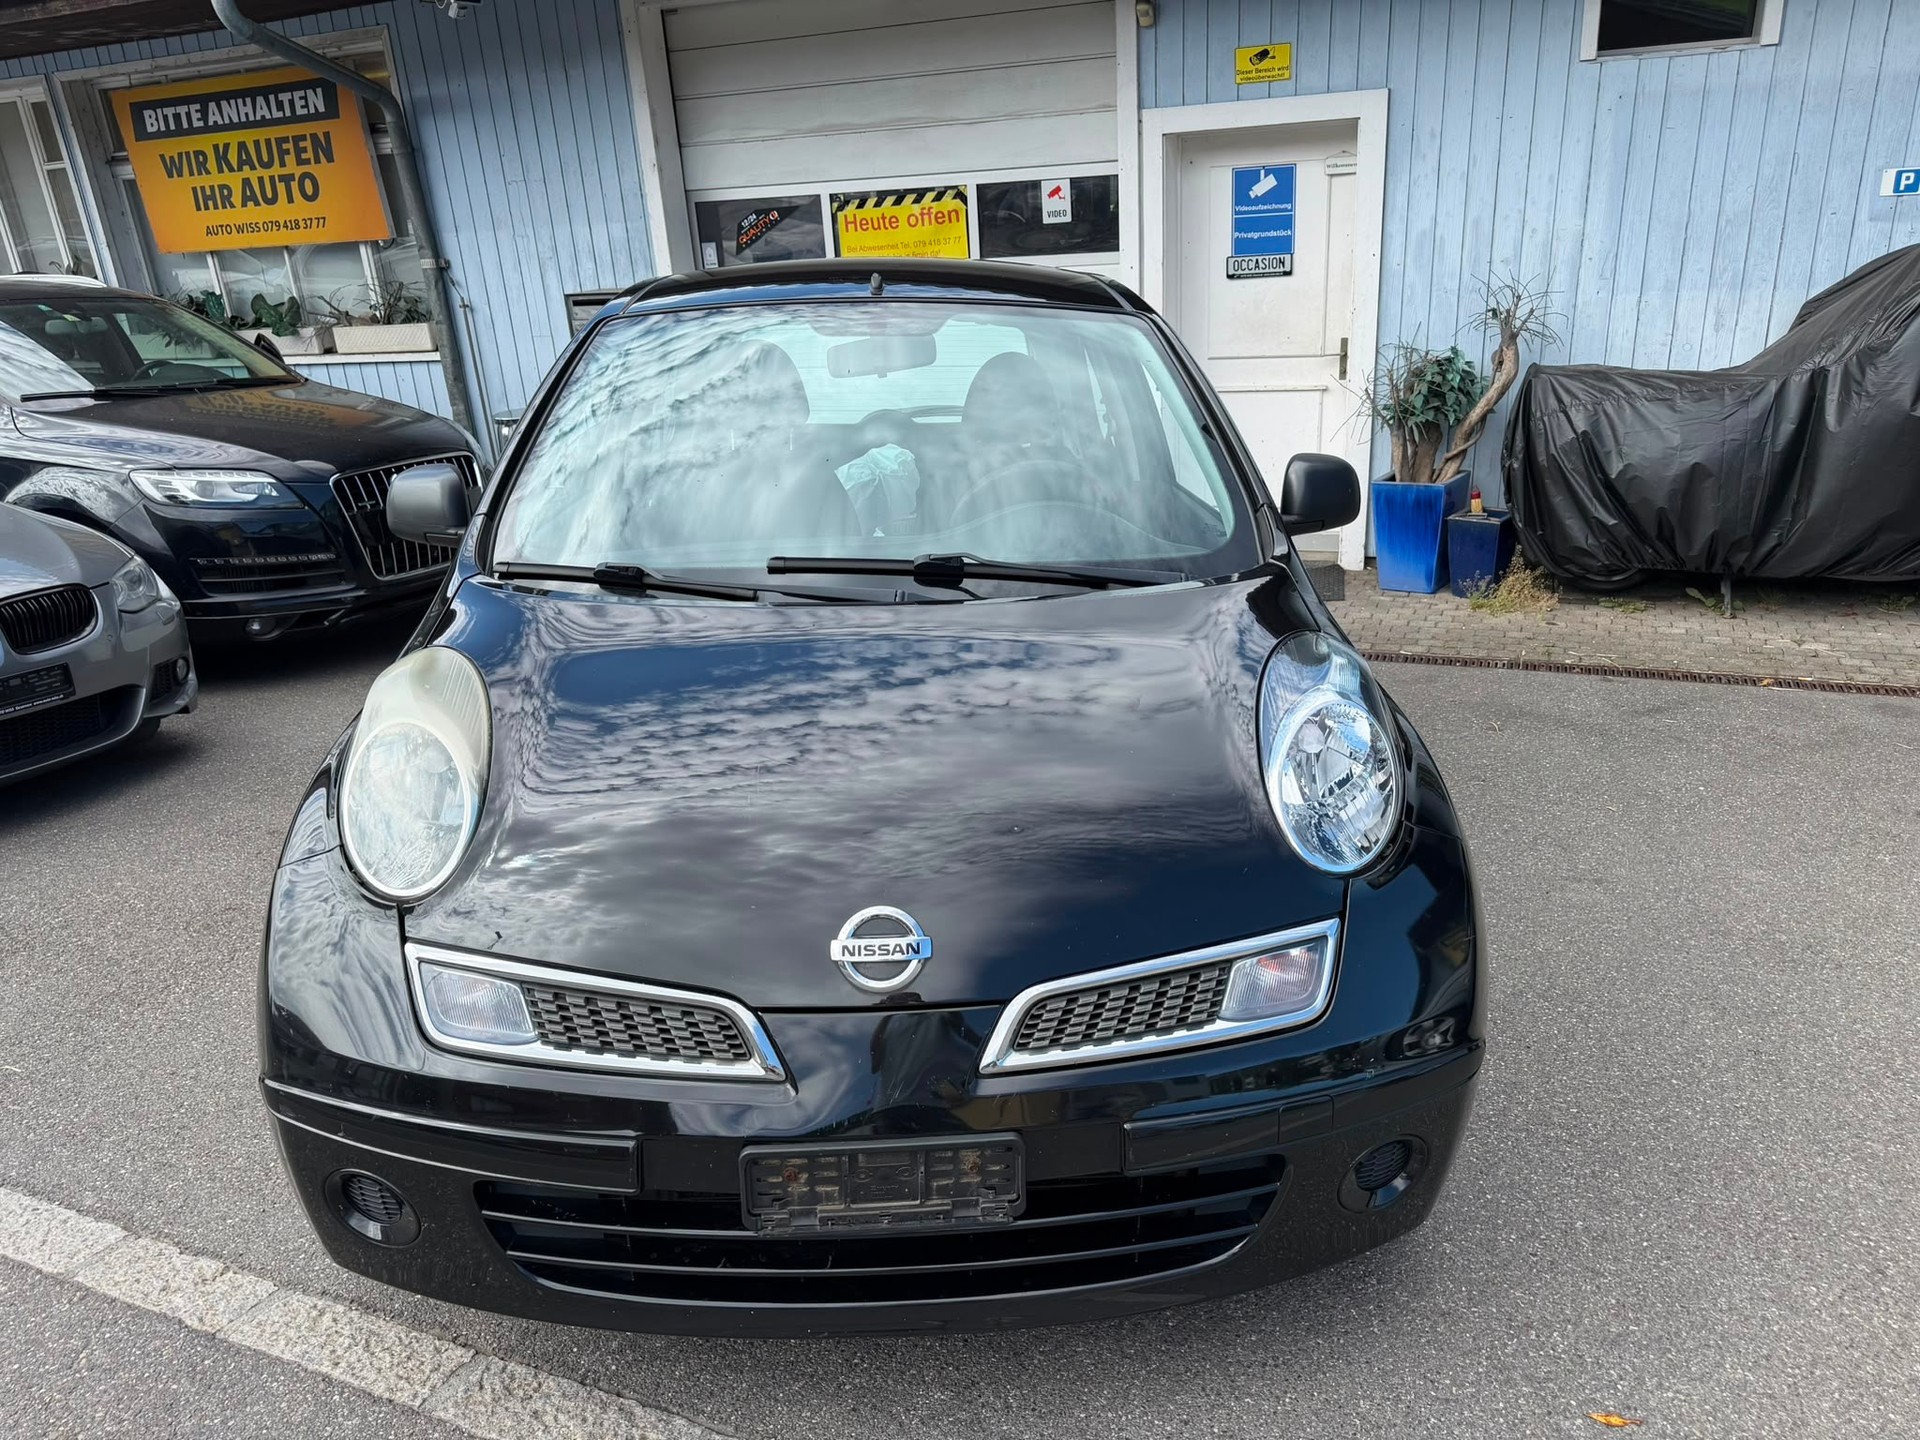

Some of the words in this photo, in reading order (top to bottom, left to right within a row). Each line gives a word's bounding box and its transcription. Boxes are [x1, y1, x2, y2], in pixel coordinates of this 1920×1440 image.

[1255, 66, 1275, 74] Bereich
[142, 106, 204, 133] BITTE
[207, 87, 326, 127] ANHALTEN
[159, 149, 211, 179] WIR
[211, 130, 335, 175] KAUFEN
[1899, 172, 1915, 191] P
[191, 182, 236, 212] IHR
[240, 171, 320, 209] AUTO
[1046, 209, 1067, 218] VIDEO
[1234, 202, 1292, 212] Videoaufzeichnung
[205, 224, 233, 237] AUTO
[233, 221, 261, 235] WISS
[262, 220, 281, 232] 079
[282, 218, 300, 231] 418
[302, 217, 313, 229] 37
[314, 216, 326, 228] 77
[843, 211, 900, 233] Heute
[906, 205, 960, 228] offen
[738, 215, 771, 244] QUALITY
[1234, 229, 1292, 239] Privatgrundstück
[846, 244, 858, 254] Bei
[859, 242, 899, 252] Abwesenheit
[913, 239, 927, 248] 079
[943, 236, 952, 246] 37
[953, 235, 961, 244] 77
[1232, 256, 1286, 272] OCCASION
[841, 941, 921, 957] NISSAN
